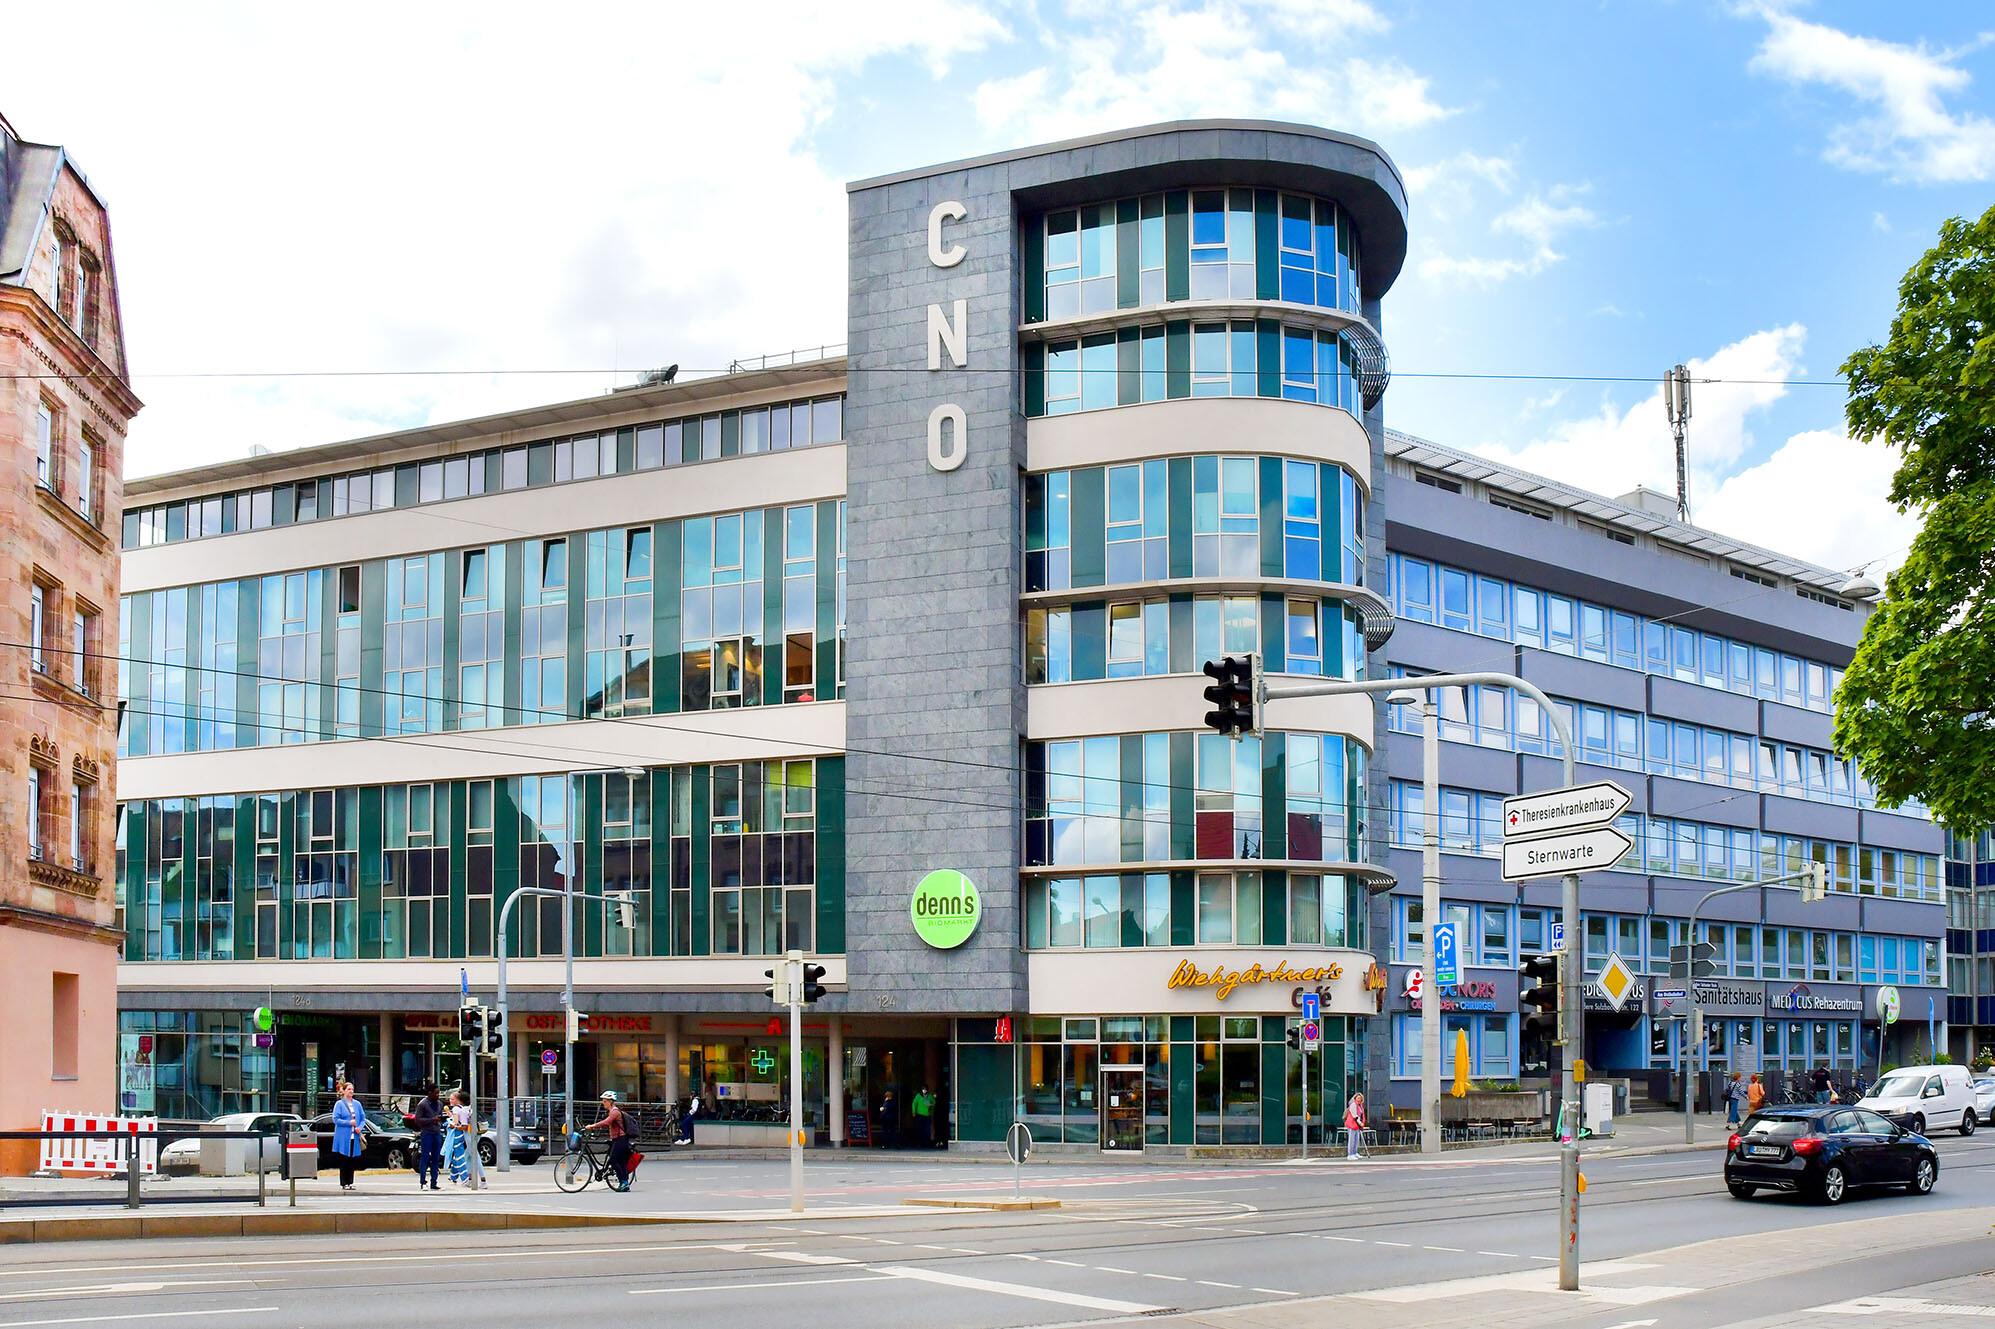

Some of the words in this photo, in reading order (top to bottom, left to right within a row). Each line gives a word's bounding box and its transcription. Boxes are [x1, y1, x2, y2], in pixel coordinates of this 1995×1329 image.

[1522, 797, 1615, 823] Theresienkrankenhaus
[1527, 845, 1594, 865] Sternwarte
[1441, 935, 1451, 959] P
[1291, 986, 1332, 1008] Cfé
[1694, 987, 1762, 1006] Sanitätshaus
[1814, 998, 1863, 1011] Rehazentrum
